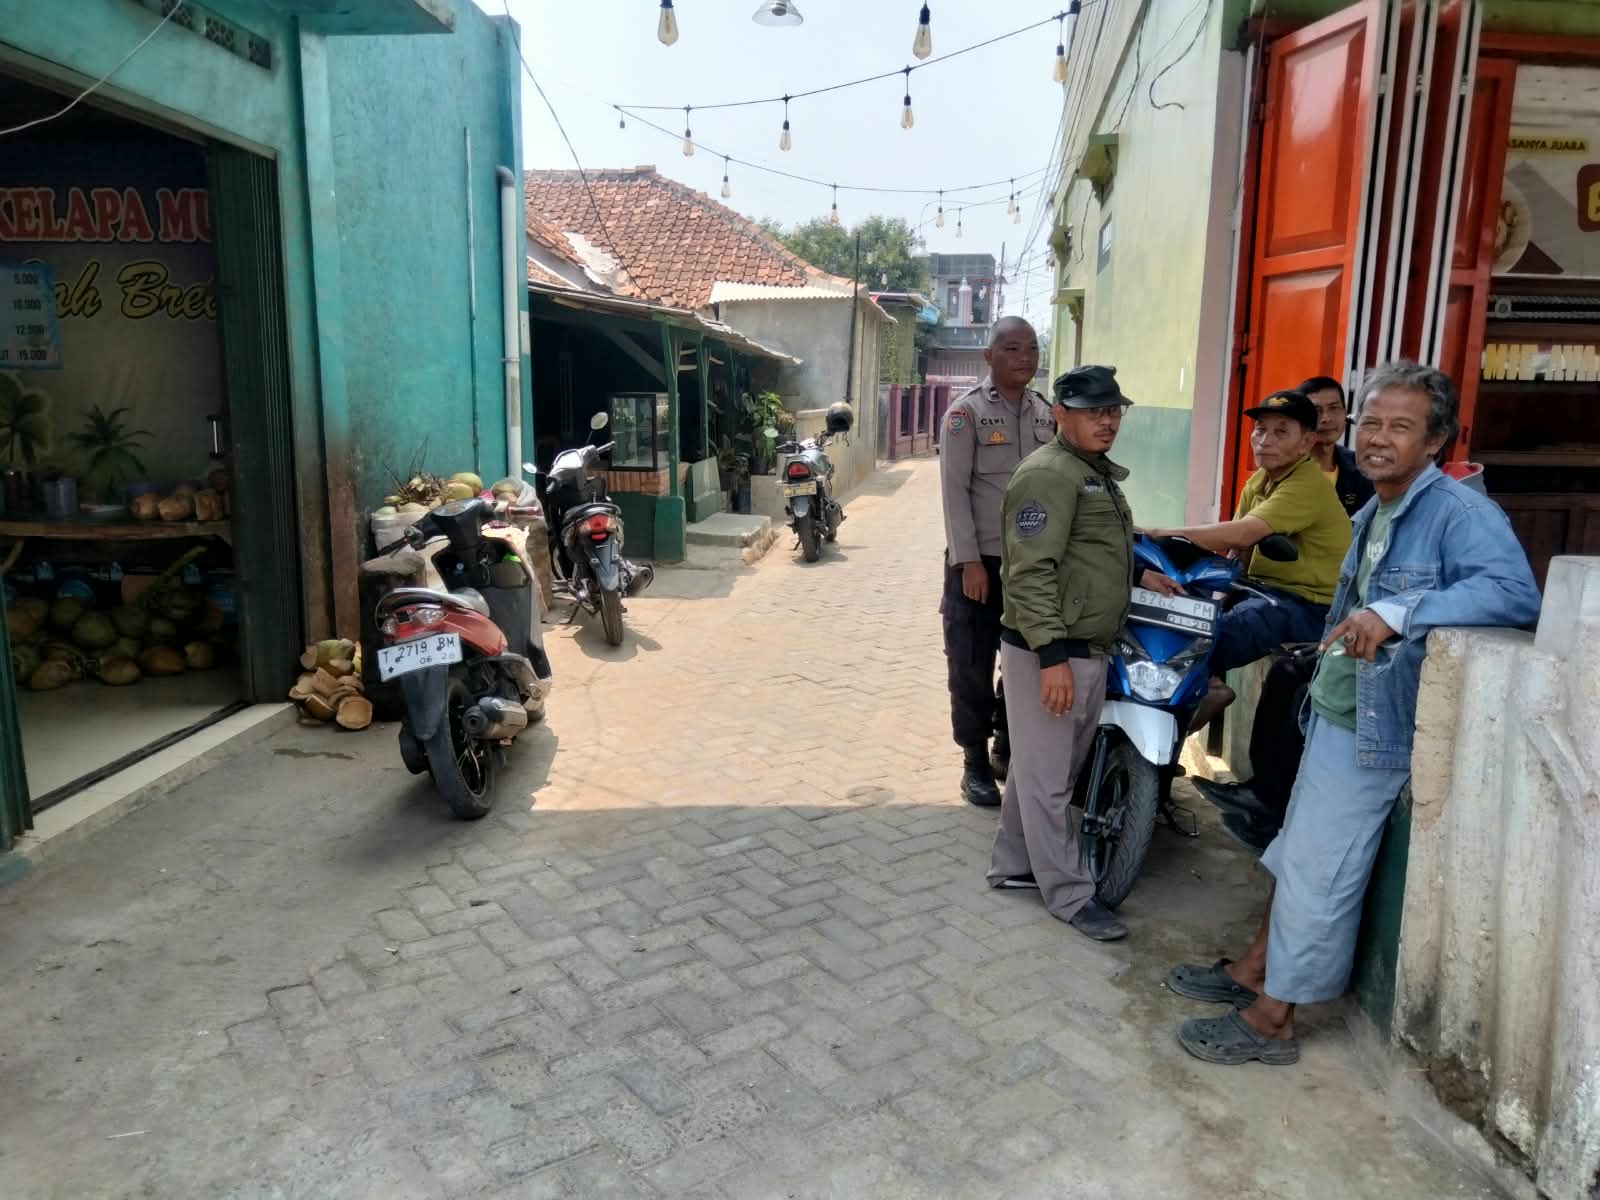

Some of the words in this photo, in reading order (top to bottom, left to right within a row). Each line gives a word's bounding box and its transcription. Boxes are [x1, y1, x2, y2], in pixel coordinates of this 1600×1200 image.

[1550, 140, 1585, 151] JUARA
[1193, 603, 1212, 619] PM
[383, 651, 389, 665] T
[399, 641, 427, 658] 2719
[437, 636, 455, 650] BM
